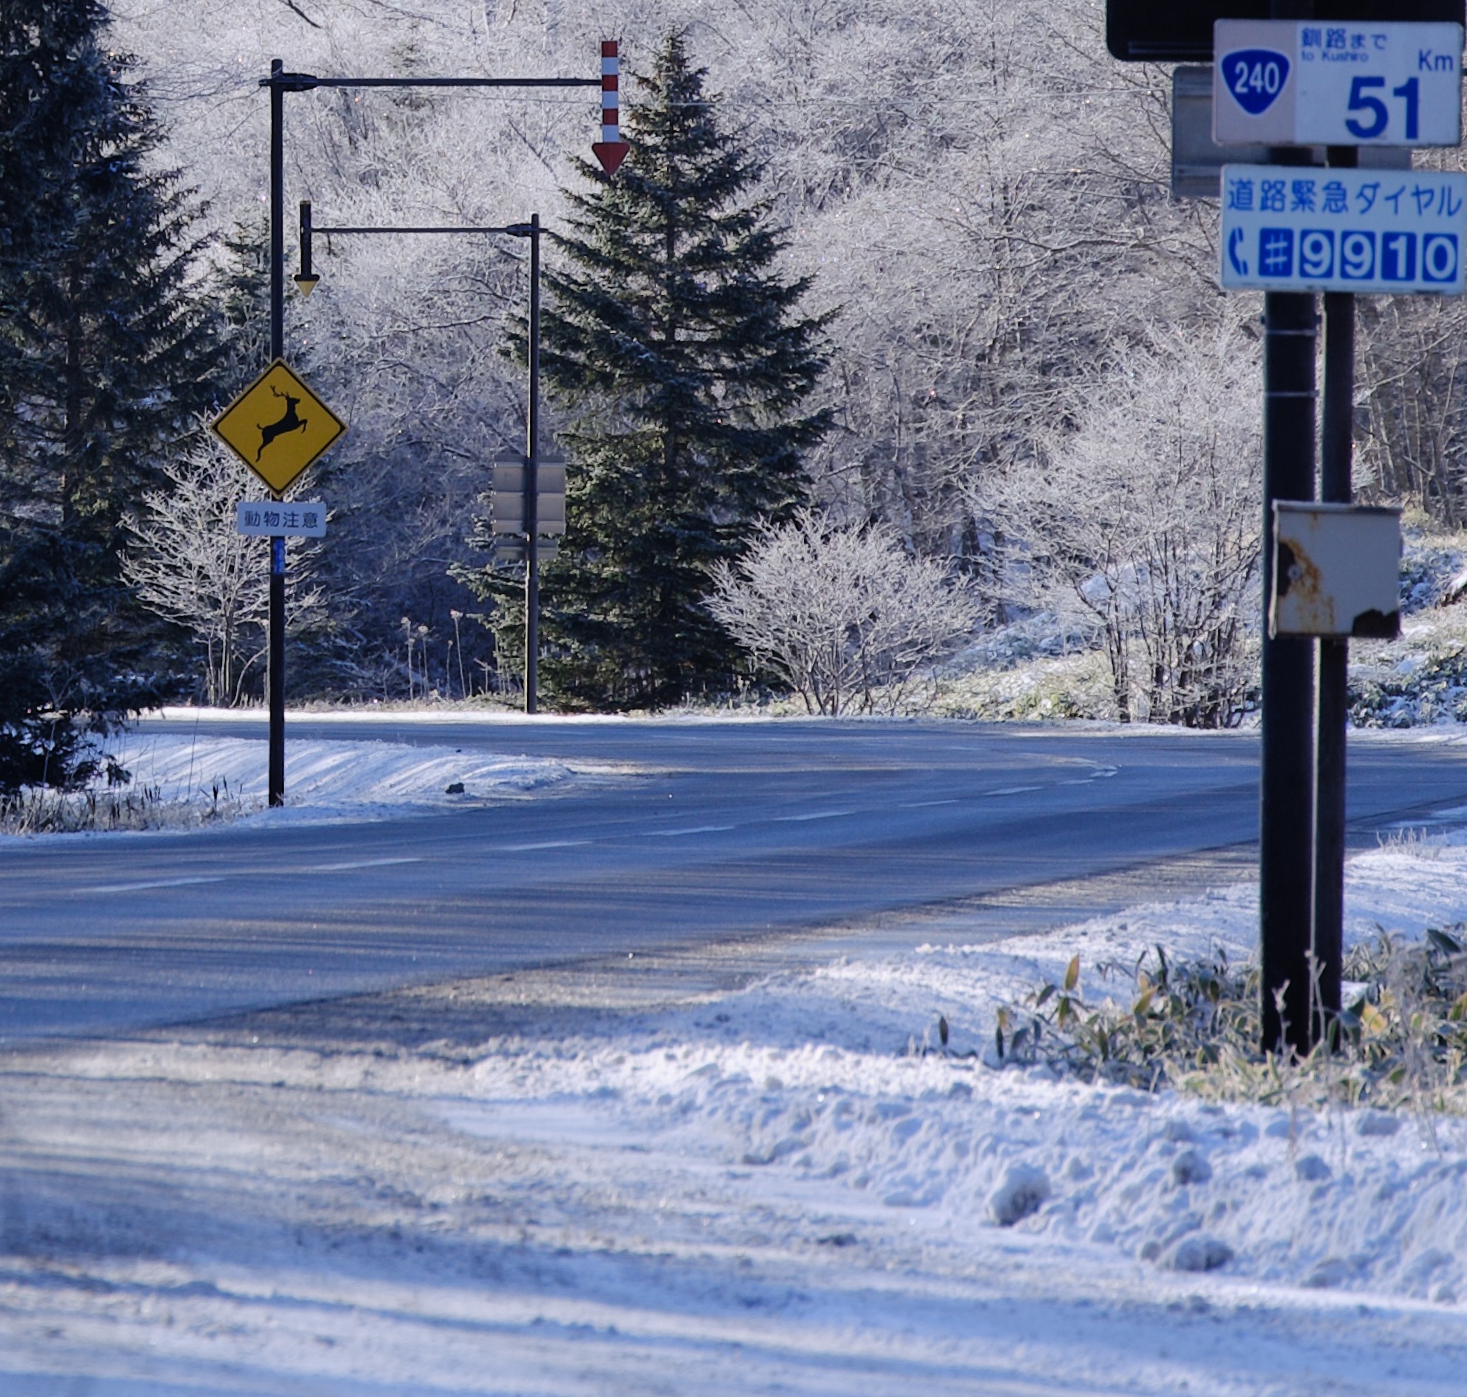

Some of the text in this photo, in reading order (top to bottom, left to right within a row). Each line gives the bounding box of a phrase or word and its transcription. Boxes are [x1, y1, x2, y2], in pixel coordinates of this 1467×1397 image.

[1302, 28, 1388, 50] 釧路まで
[1418, 49, 1454, 71] Km
[1234, 61, 1280, 94] 240
[1345, 76, 1419, 140] 51
[1228, 178, 1463, 217] 道路緊急ダイヤル
[1264, 231, 1457, 280] #9910
[244, 510, 319, 529] 動物注意
